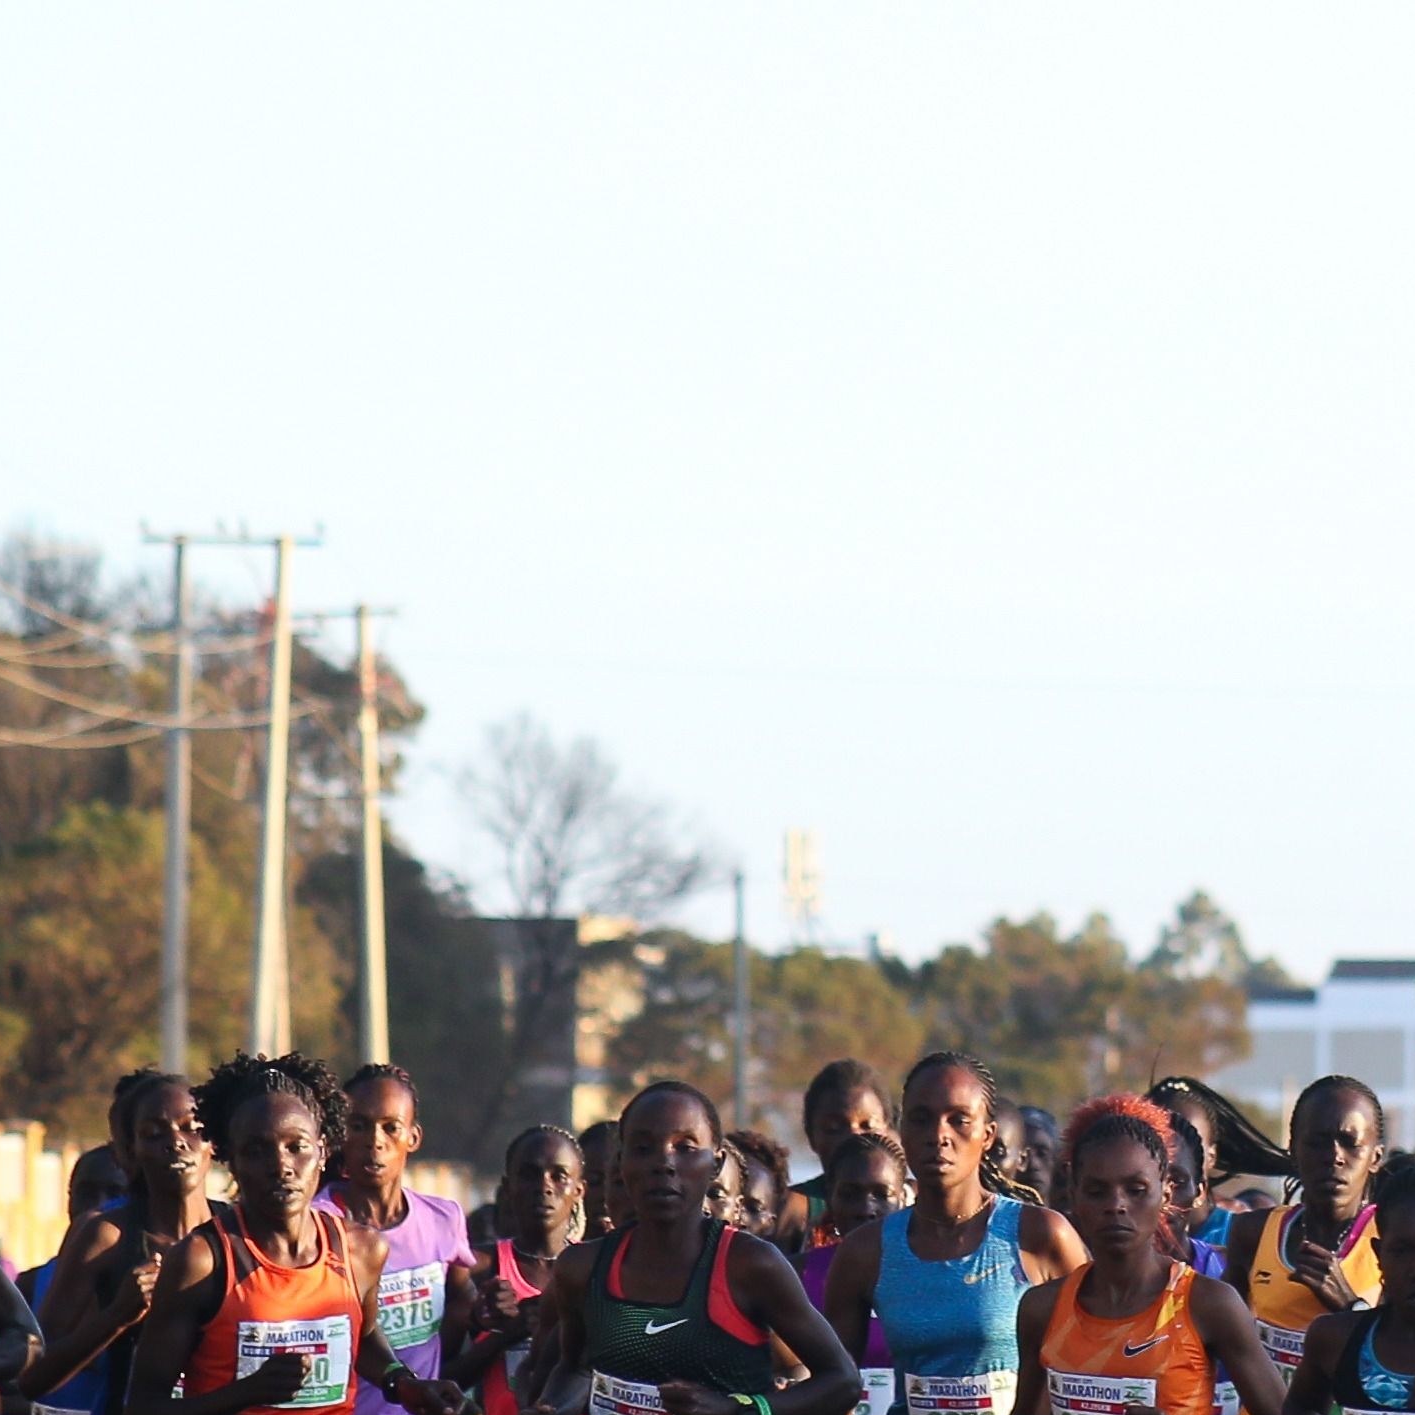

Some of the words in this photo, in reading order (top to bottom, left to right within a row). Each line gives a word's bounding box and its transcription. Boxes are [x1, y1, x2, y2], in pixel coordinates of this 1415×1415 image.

[377, 1300, 433, 1330] 2376
[266, 1329, 324, 1344] MARATHON
[612, 1387, 662, 1409] MARATHO
[929, 1383, 987, 1397] MARATHON
[1062, 1383, 1121, 1400] MARATHON
